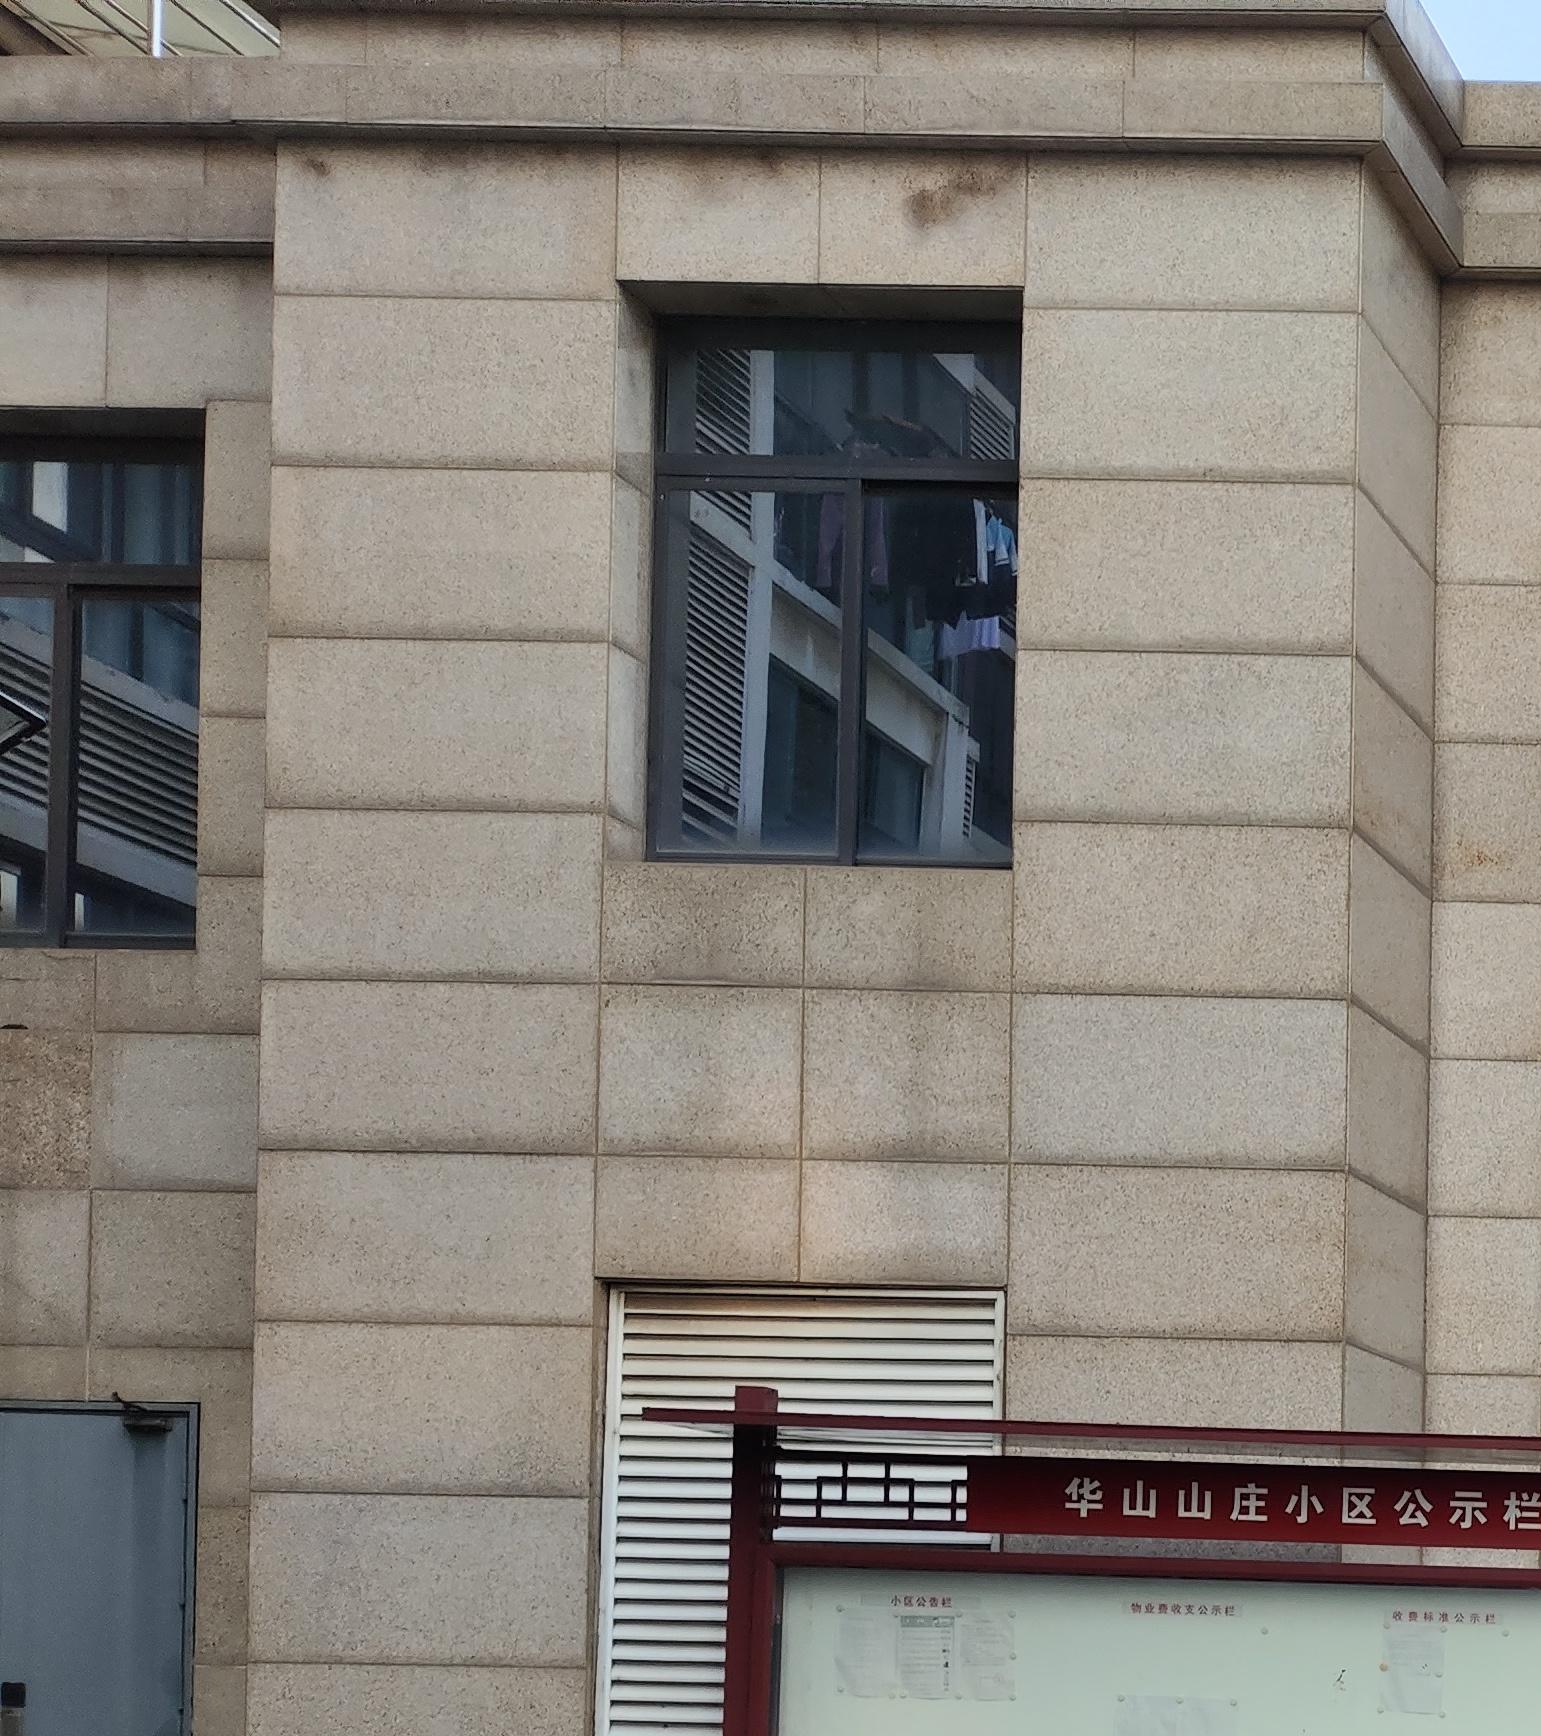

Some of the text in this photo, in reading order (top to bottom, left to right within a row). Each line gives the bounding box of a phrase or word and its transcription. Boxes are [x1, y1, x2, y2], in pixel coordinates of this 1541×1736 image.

[890, 1594, 953, 1609] 小区公告栏
[1129, 1602, 1236, 1617] 物业费收支公示栏
[1392, 1610, 1496, 1625] 收费标准公示栏
